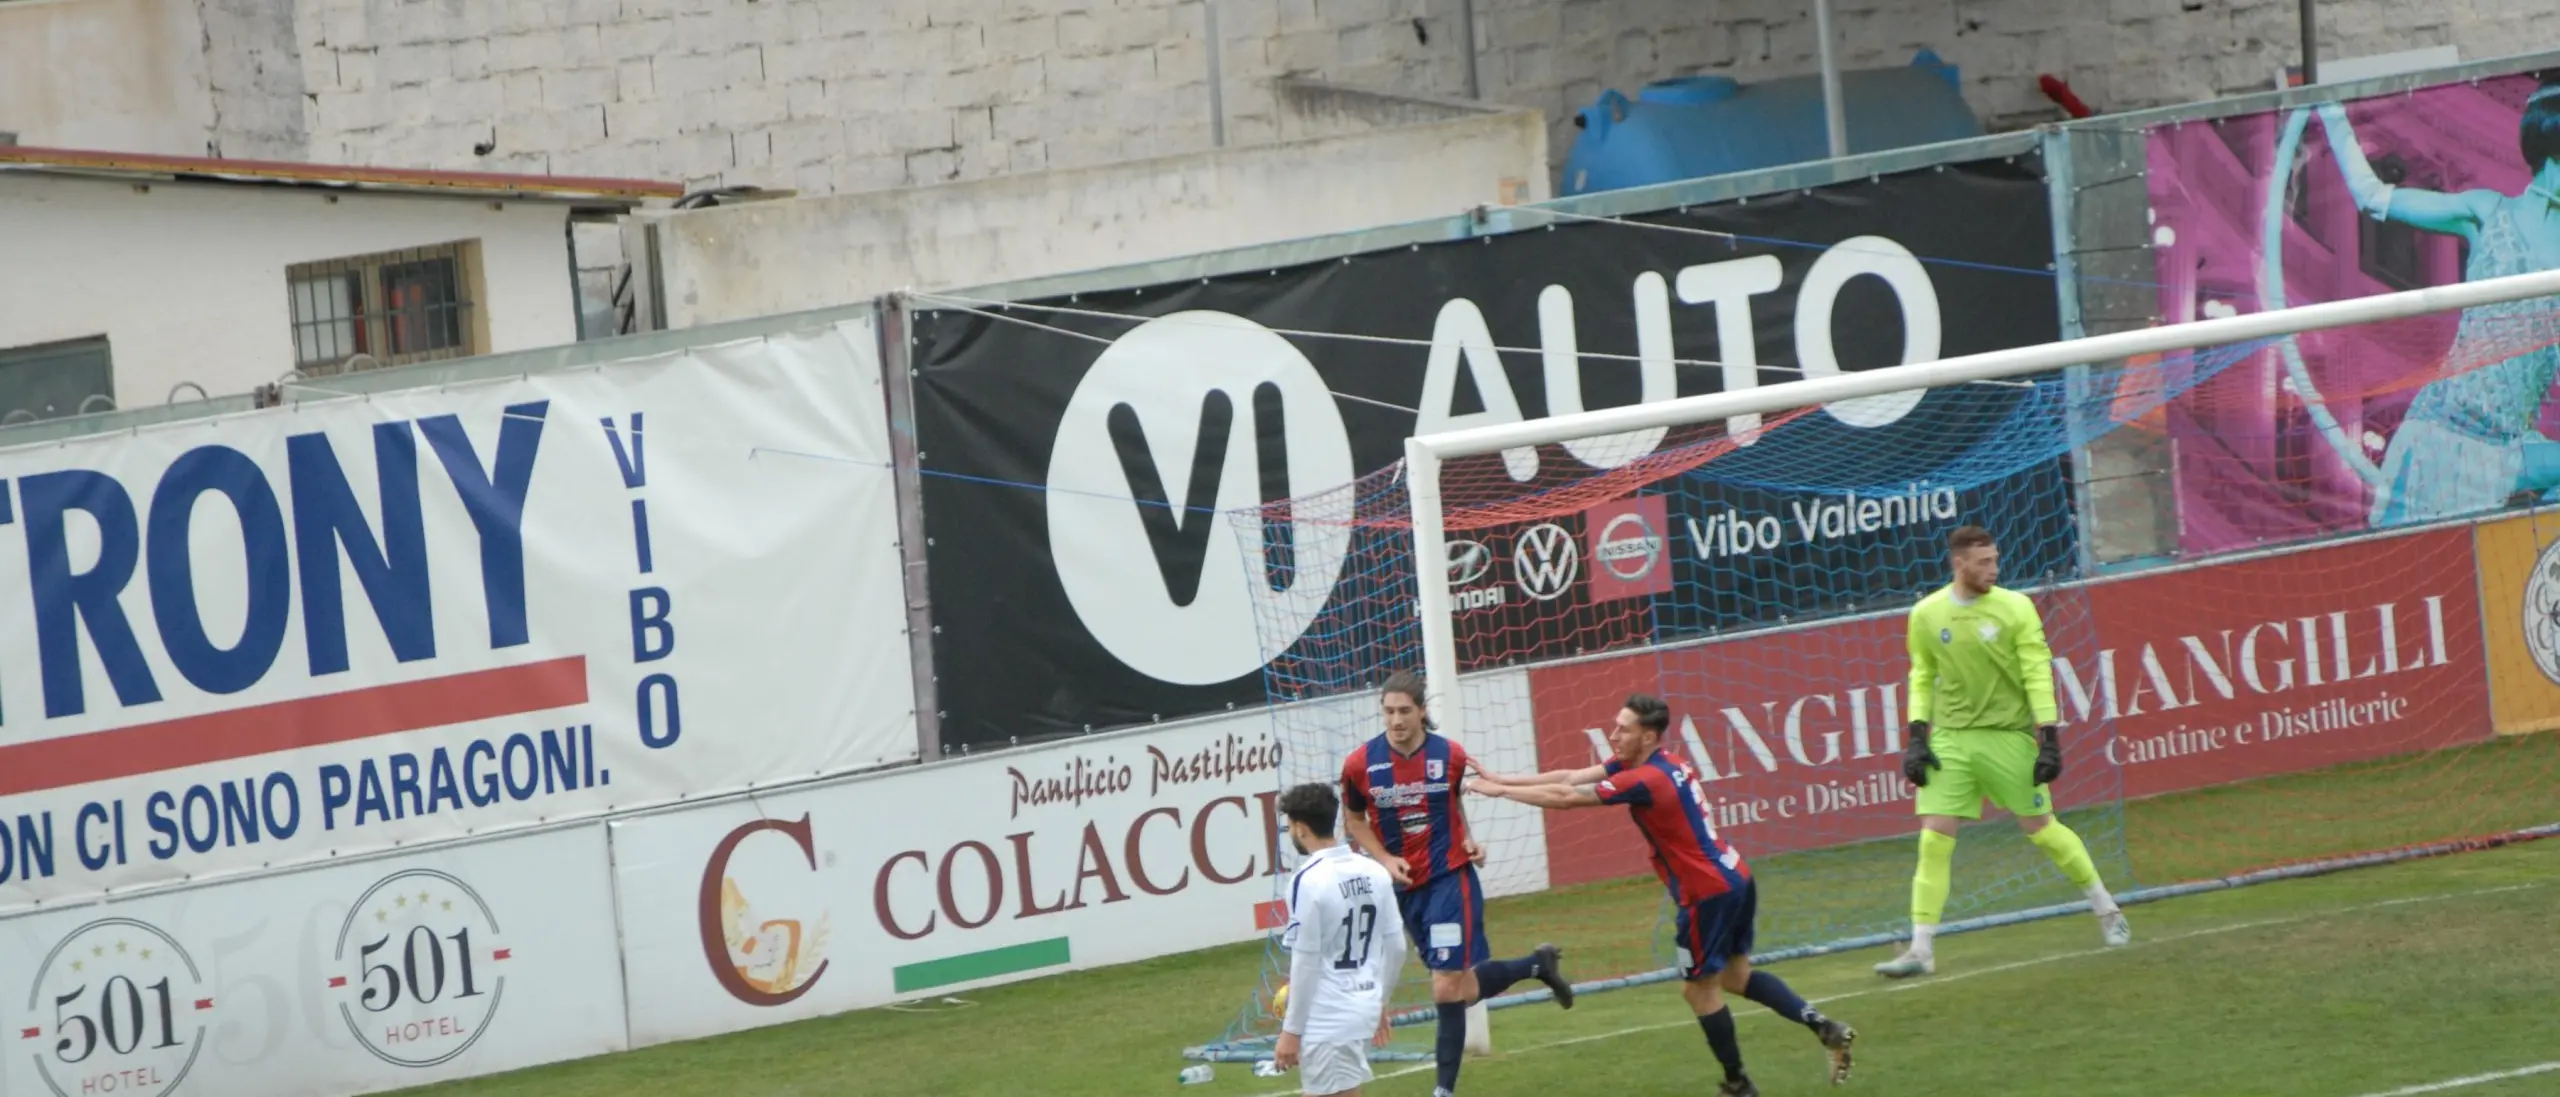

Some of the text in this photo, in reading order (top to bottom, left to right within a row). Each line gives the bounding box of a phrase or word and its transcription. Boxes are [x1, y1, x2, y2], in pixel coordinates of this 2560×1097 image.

[1107, 235, 1942, 608] VI AUTO
[0, 399, 550, 720] RONY
[1603, 540, 1659, 557] NISSAN
[1688, 508, 1781, 560] Vibo
[600, 411, 682, 749] VIBO
[2053, 595, 2452, 728] MANGILLI
[2104, 690, 2409, 767] Cantine e Distillerie
[76, 799, 128, 871] CI
[146, 771, 300, 860] SONO
[319, 724, 610, 832] PARAGONI.
[1007, 733, 1283, 819] Panificio Pastificio
[1777, 793, 1797, 819] e
[360, 925, 485, 1012] 501
[54, 974, 185, 1063] 501
[385, 1016, 465, 1045] HOTEL
[81, 1068, 163, 1097] HOTEL
